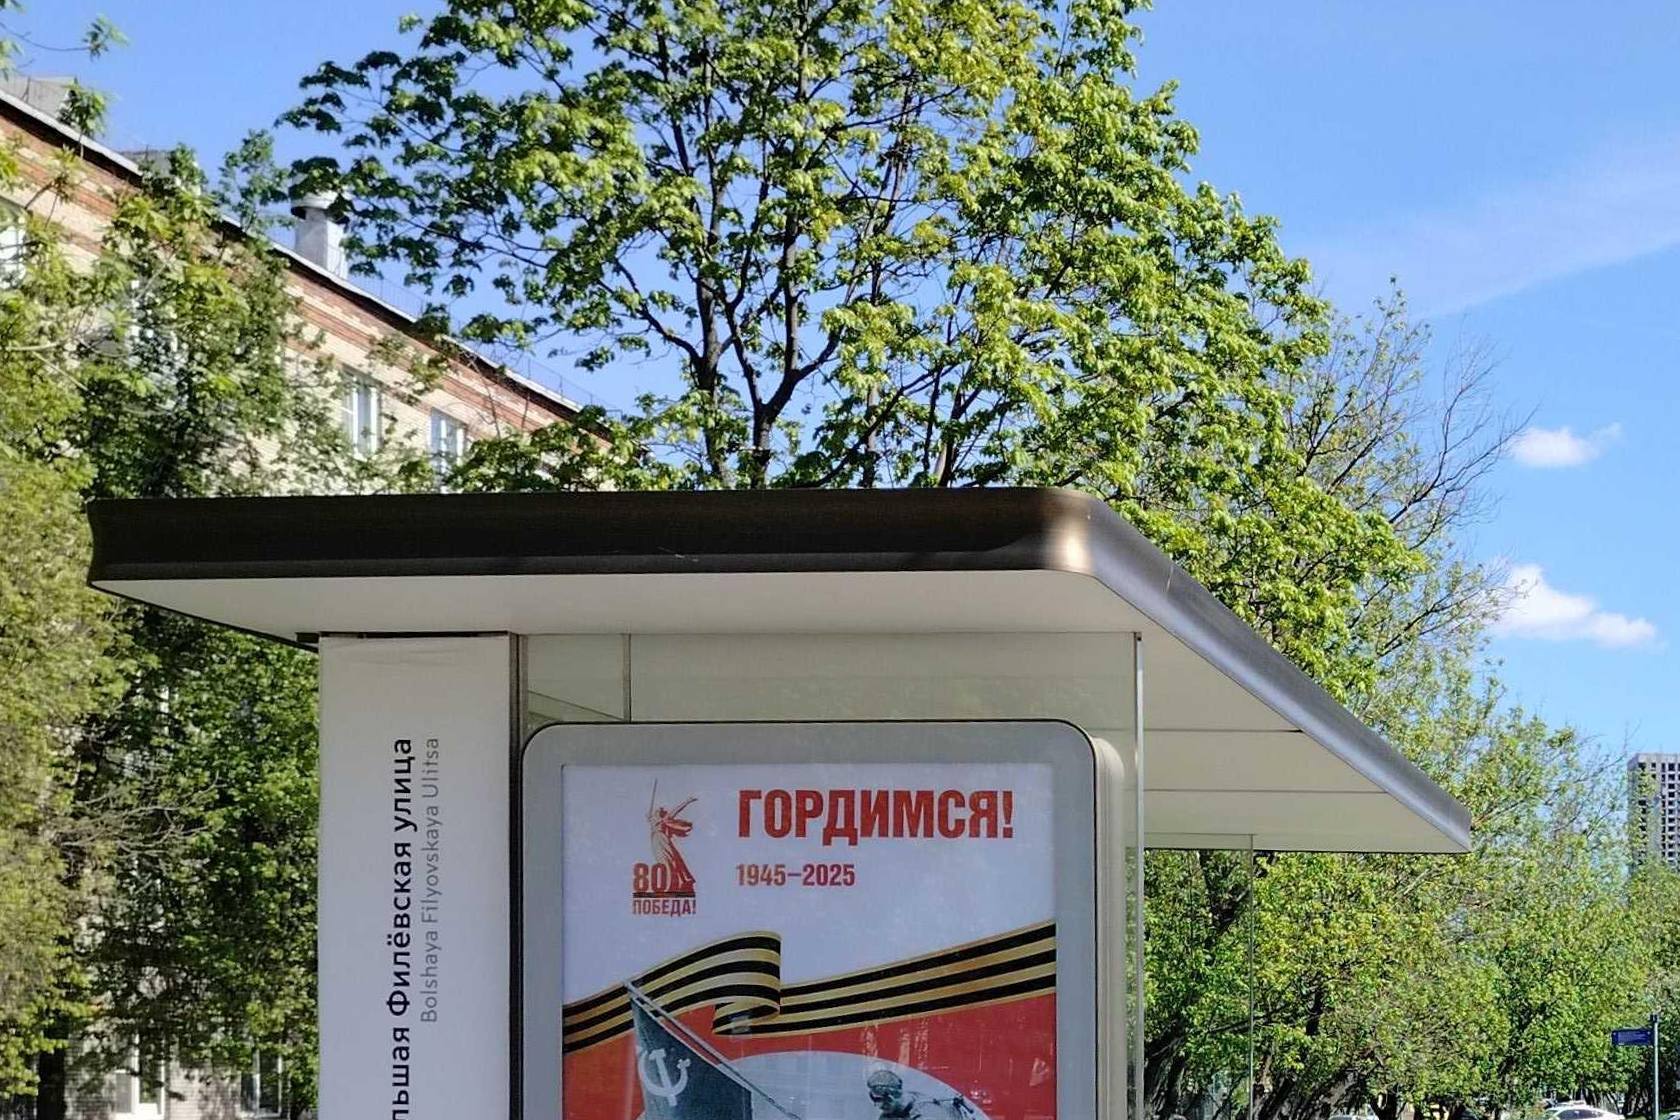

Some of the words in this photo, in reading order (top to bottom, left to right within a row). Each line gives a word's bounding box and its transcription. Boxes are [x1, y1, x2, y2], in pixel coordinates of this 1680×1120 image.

[393, 739, 418, 832] улица
[421, 738, 439, 799] Ulitsa
[738, 789, 1013, 846] ГОРДИМСЯ!
[420, 806, 443, 923] Filyovskaya
[633, 863, 669, 892] 80
[386, 842, 412, 1017] Филёвская
[633, 899, 697, 917] ПОБЕДА!
[420, 930, 443, 1023] Bolshaya
